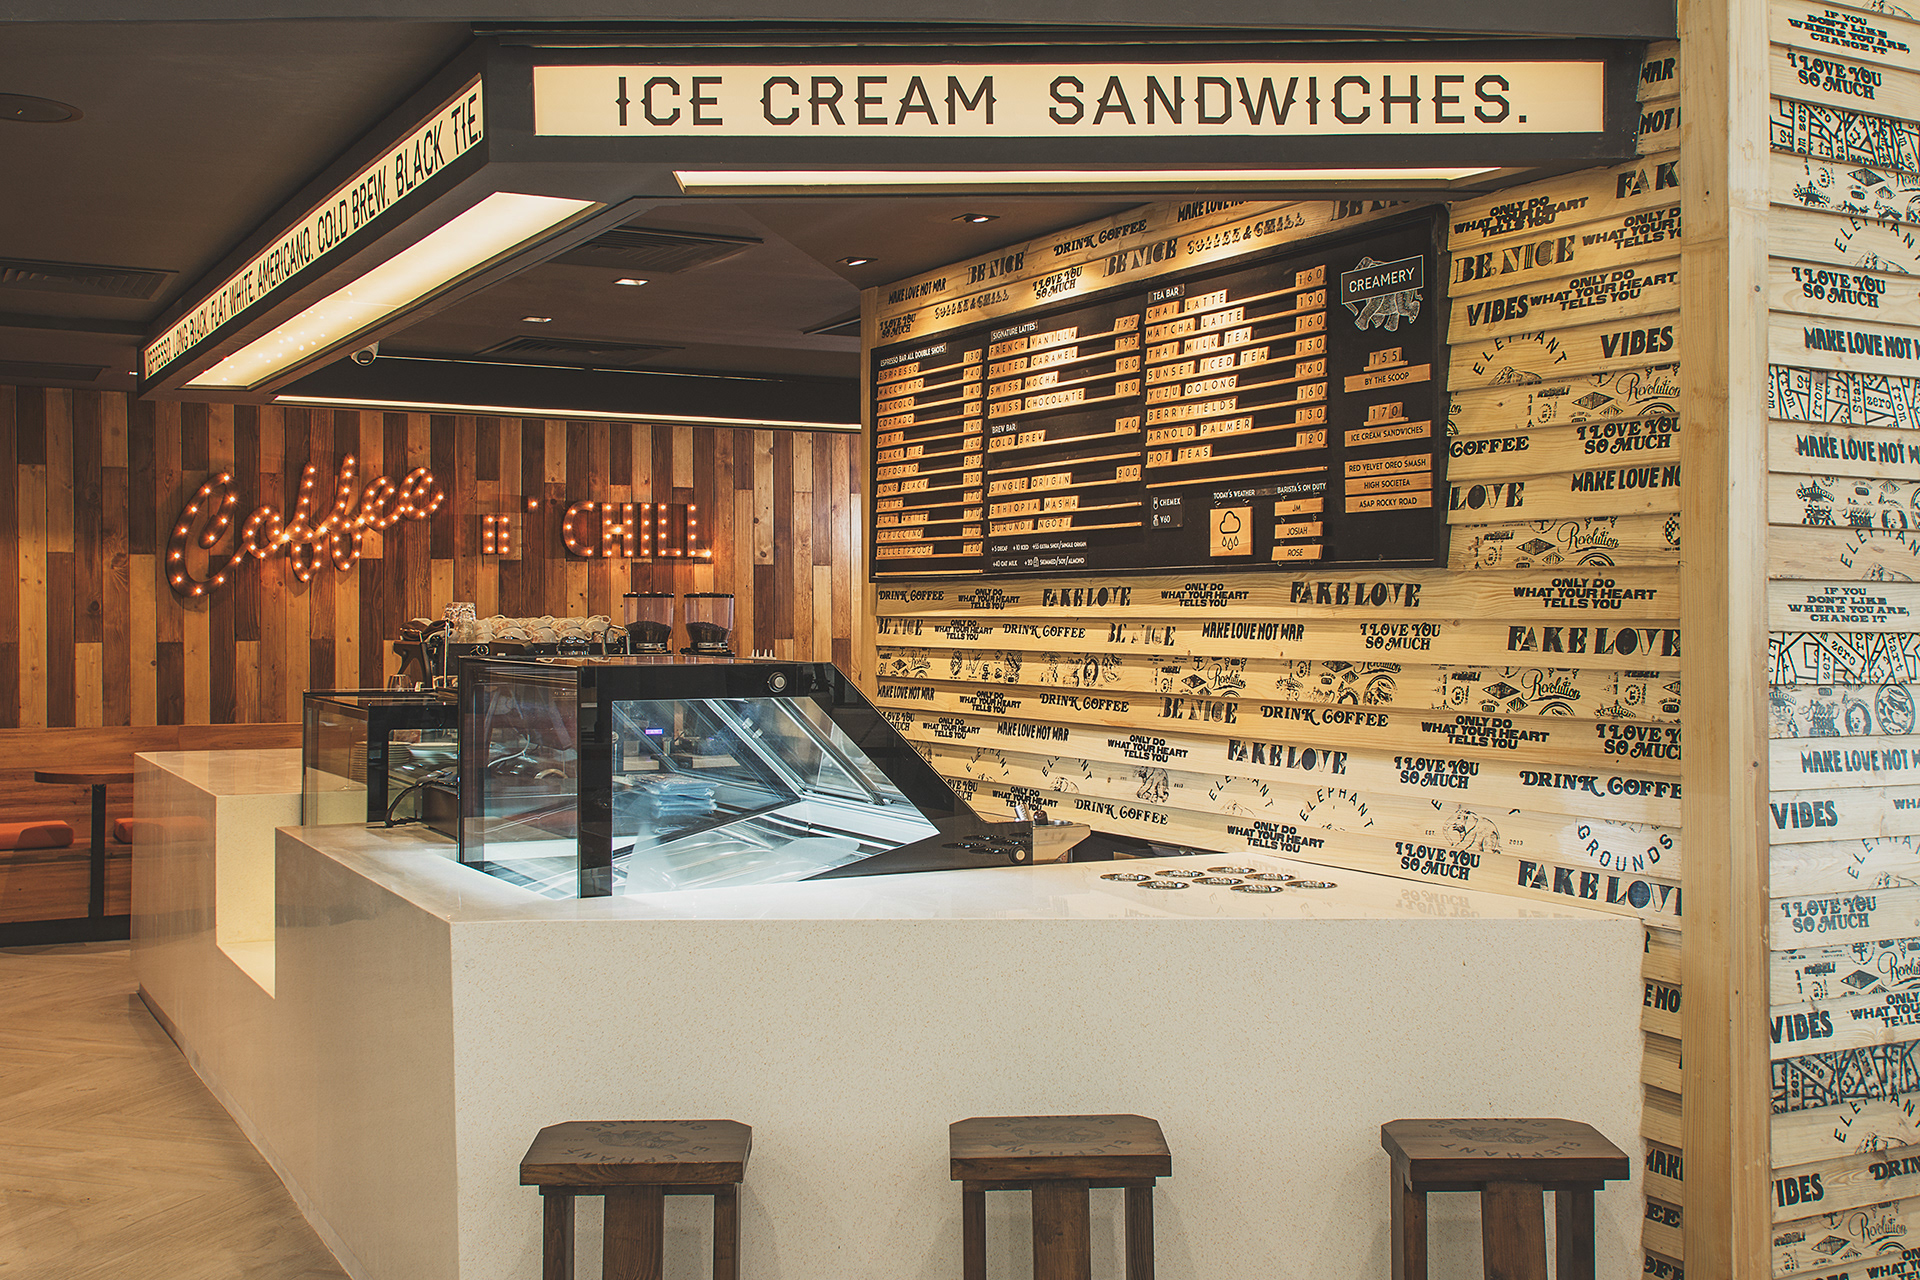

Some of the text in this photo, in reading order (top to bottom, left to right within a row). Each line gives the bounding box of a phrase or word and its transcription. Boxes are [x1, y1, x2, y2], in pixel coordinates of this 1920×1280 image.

[615, 75, 1527, 126] ICE CREAM SANDWICHES.
[211, 290, 227, 329] FLAT
[258, 226, 313, 296] AMERICANO.
[317, 199, 347, 252] COLD
[352, 165, 390, 229] BREW.
[395, 120, 445, 197] BLACK
[451, 93, 482, 155] TIE.
[967, 252, 1024, 286] BE NICE
[1453, 234, 1576, 284] BE NICE
[1349, 267, 1415, 292] CREAMERY
[1792, 266, 1886, 294] I LOVE YOU
[1148, 268, 1322, 318] CHAI LATTE 160
[1153, 287, 1178, 300] TEA BAR
[1802, 283, 1880, 308] SO MUCH
[1147, 294, 1323, 338] MATCHA LATTE 190
[990, 318, 1135, 354] FRENCH VANILLA 195
[992, 327, 1018, 340] SIGNATURE
[1148, 316, 1322, 358] THAI MILK TEA 160
[1600, 326, 1674, 358] VIBES
[990, 338, 1136, 375] SALTED CARAMEL 195
[1148, 339, 1322, 380] SUNSET ICED TEA 130
[1373, 351, 1398, 364] 155
[880, 365, 917, 380] ESPRESSO
[990, 359, 1137, 394] SWISS MOCHA 180
[1148, 362, 1322, 400] YUZU OOLONG 160
[1364, 372, 1410, 386] BY THE SCOOP
[991, 382, 1136, 414] SWISS CHOCOLATE 180
[1148, 385, 1323, 420] BERRYFIELDS 160
[1866, 396, 1892, 410] zero
[1372, 406, 1398, 419] 170
[991, 420, 1136, 448] COLD BREW 140
[992, 423, 1016, 434] BREW BAR
[1148, 408, 1322, 441] ARNOLD PALMER 130
[1351, 426, 1424, 442] ICE CREAM SANDWICHES
[1149, 432, 1323, 462] HOT TEAS 120
[1348, 458, 1426, 472] RED VELVET OREO SMASH
[991, 468, 1138, 492] SINGLE ORIGIN 200
[1277, 482, 1326, 494] BARISTA'S ON DUTY
[1364, 479, 1410, 489] HIGH SOCIETEA
[1160, 498, 1180, 506] CHEMEX
[1213, 490, 1256, 500] TODAY'S WEATHER
[1359, 497, 1418, 508] ASAP ROCKY ROAD
[991, 499, 1076, 514] ETHIOPIA MASHA
[165, 452, 443, 597] Coffee
[562, 501, 713, 558] CHILL
[992, 518, 1069, 532] BURUNDI NGOZI
[1160, 515, 1170, 523] V60
[1287, 527, 1308, 536] JOSIAH
[1288, 549, 1303, 557] ROSE
[1513, 587, 1658, 600] WHAT YOUR HEART
[1551, 578, 1616, 588] ONLY DO
[1824, 587, 1866, 596] IF YOU
[1290, 582, 1422, 608] FAKE LOVE
[1543, 598, 1622, 610] TELLS YOU
[1806, 596, 1887, 606] DON'T LIKE
[1788, 604, 1910, 617] WHERE YOU ARE,
[1809, 614, 1887, 623] CHANGE IT
[1002, 624, 1086, 638] DRINK COFFEE
[1202, 622, 1305, 642] MAKE LOVE NOT WAR
[1508, 626, 1680, 657] FAKE LOVE
[1260, 705, 1389, 728] DRINK COFFEE
[1228, 739, 1348, 775] FAKE LOVE
[1770, 800, 1838, 830] VIBES
[1578, 824, 1674, 872] GROUNDS
